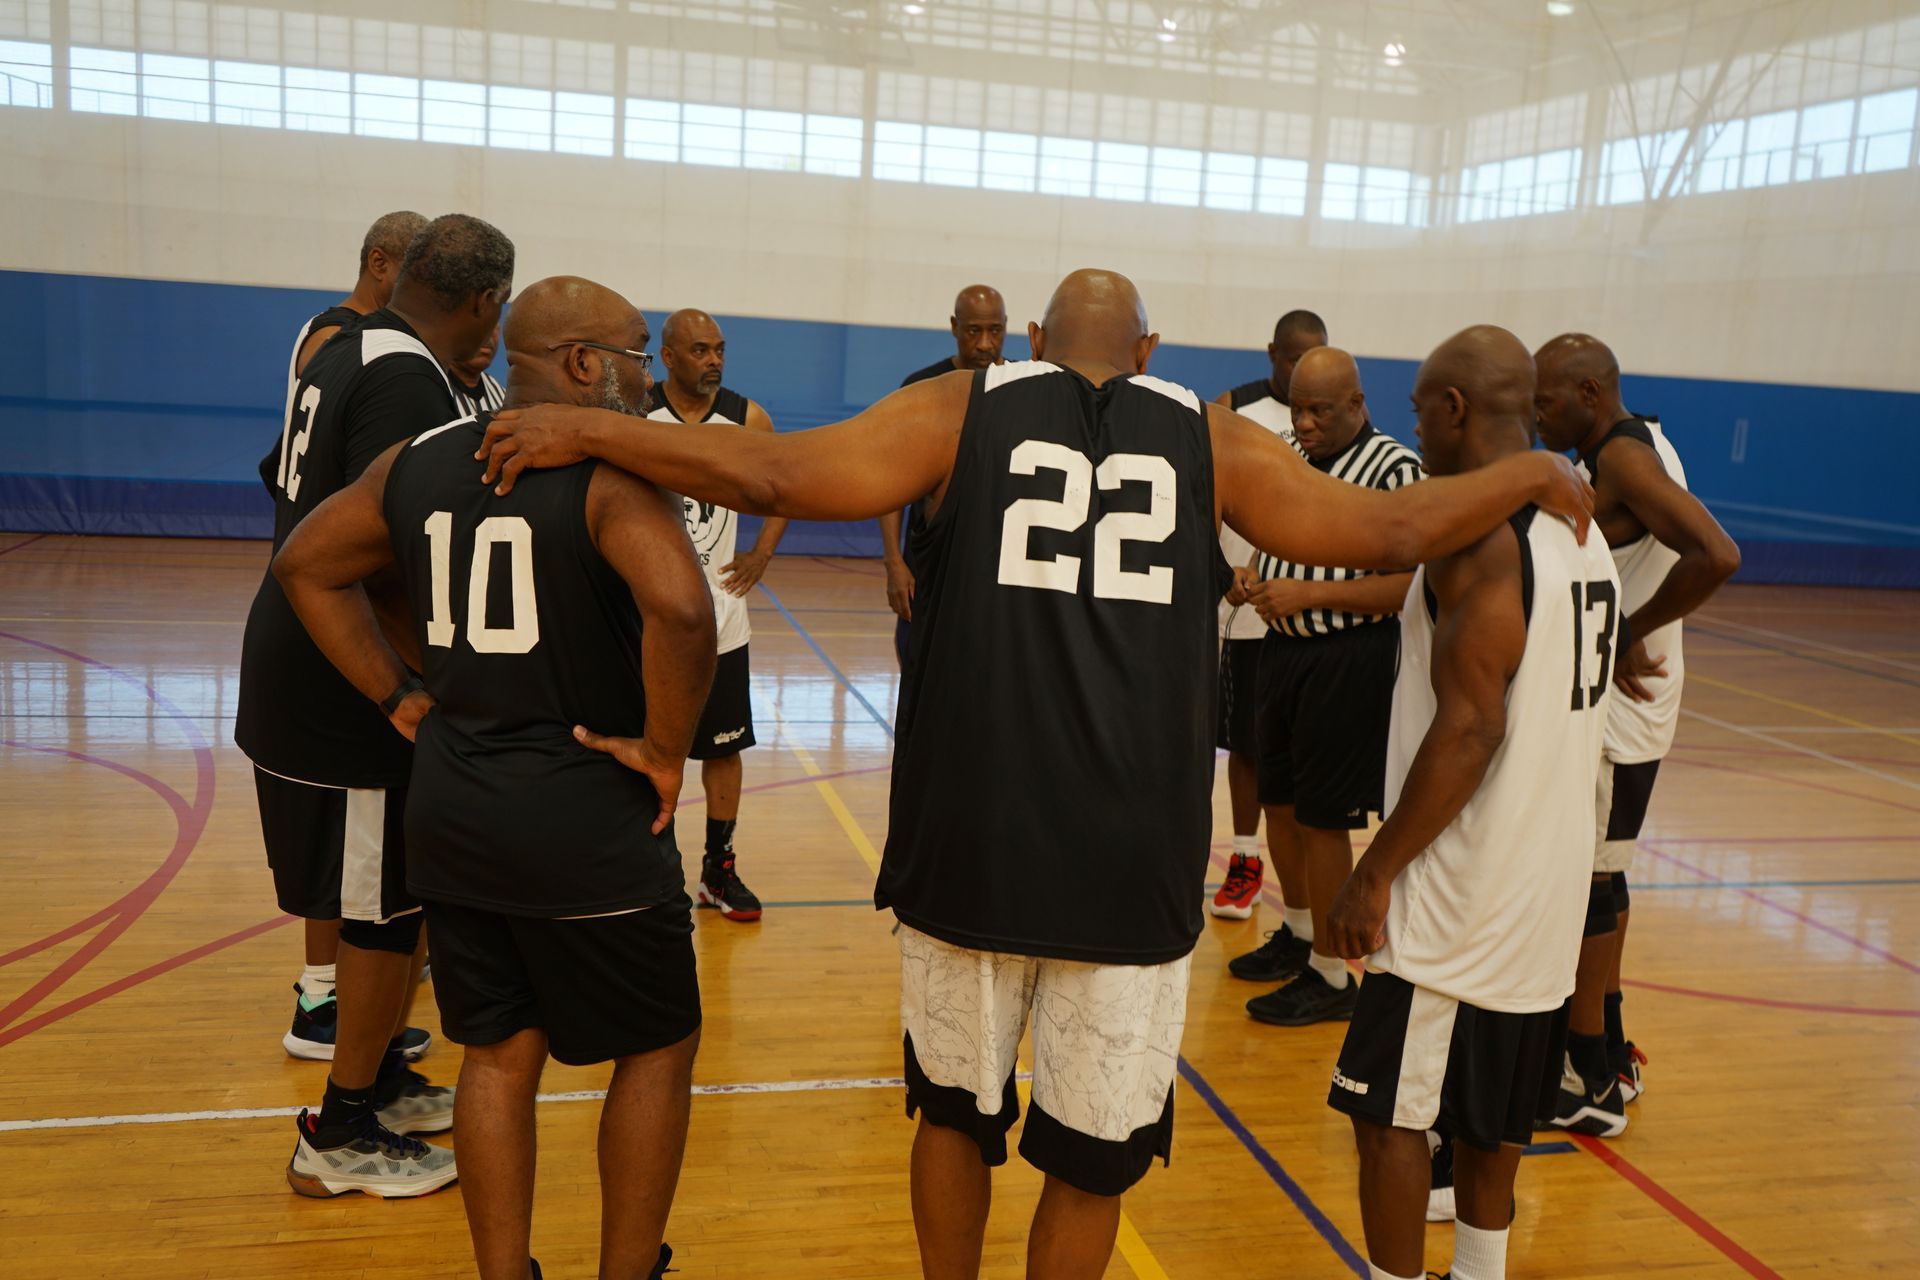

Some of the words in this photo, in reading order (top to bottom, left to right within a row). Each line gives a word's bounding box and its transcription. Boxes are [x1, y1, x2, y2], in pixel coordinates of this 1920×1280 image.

[277, 384, 321, 502] 12
[424, 510, 540, 654] 10
[998, 439, 1177, 605] 22
[1570, 579, 1616, 712] 13
